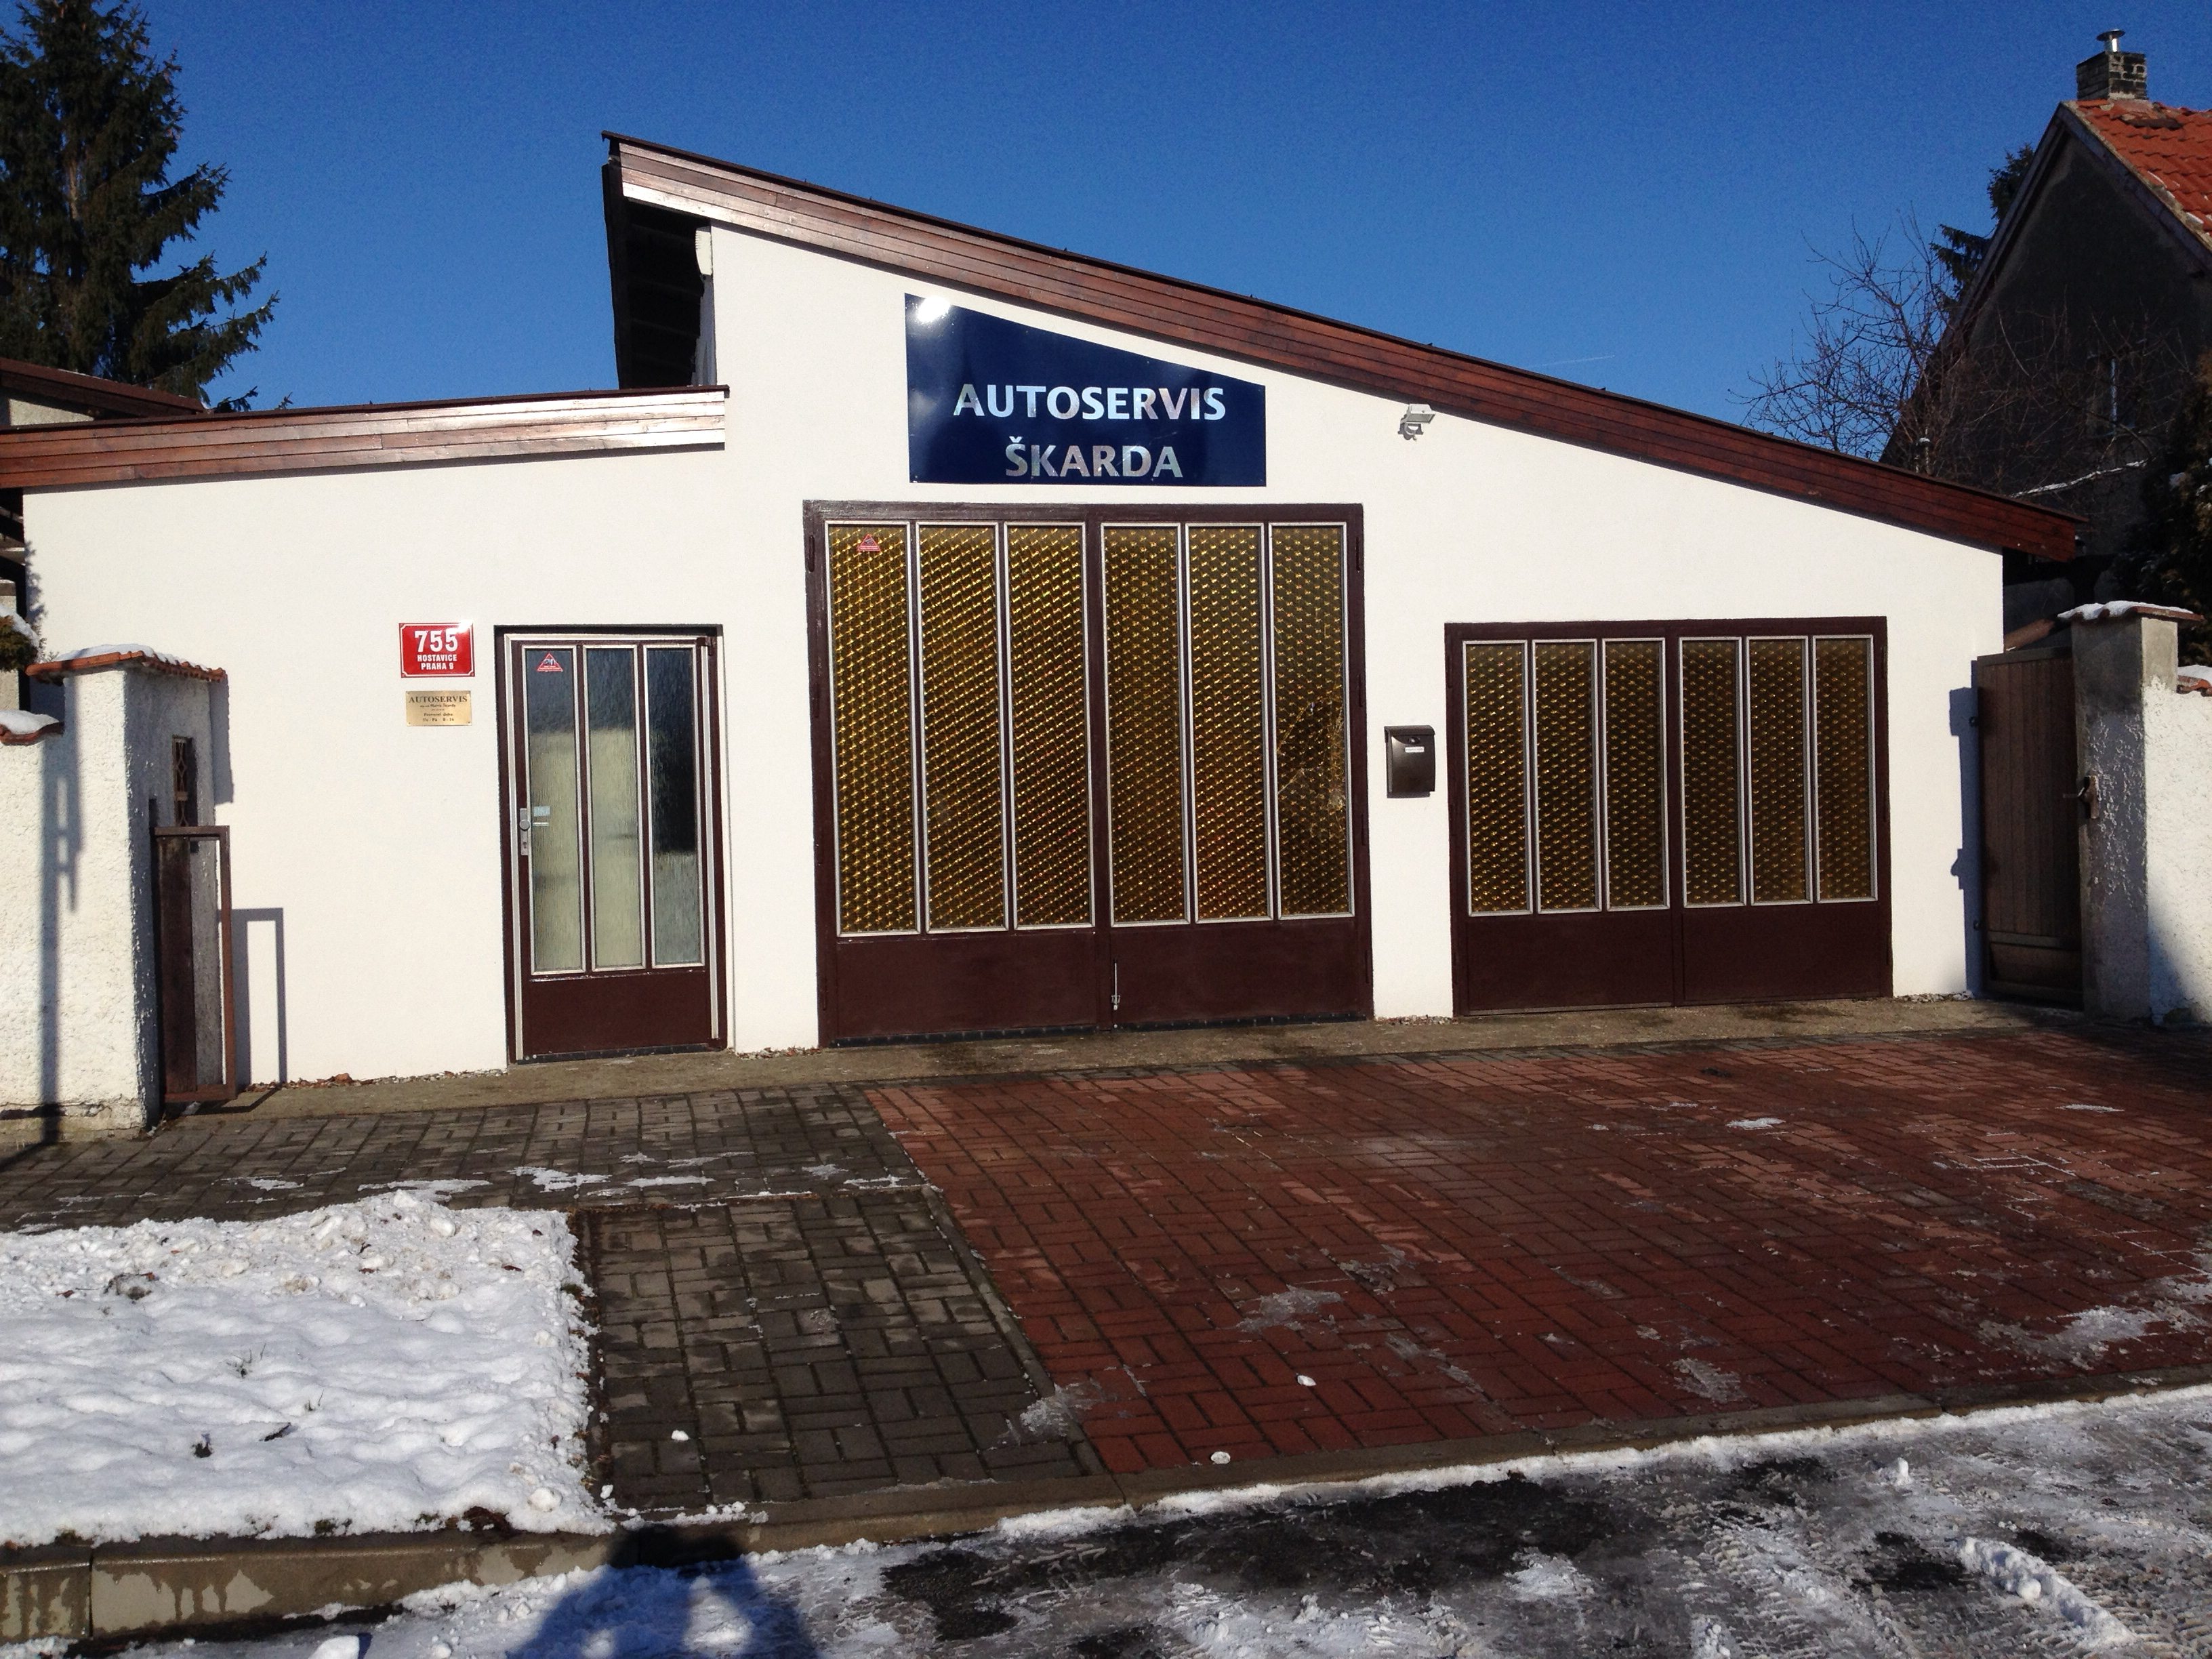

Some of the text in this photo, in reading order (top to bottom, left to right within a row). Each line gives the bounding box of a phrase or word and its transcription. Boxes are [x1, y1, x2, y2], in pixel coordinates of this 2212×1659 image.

[954, 384, 1226, 420] AUTOSERVIS
[1006, 436, 1183, 478] ŠKARDA
[415, 629, 458, 653] 755
[417, 654, 457, 662] HOSTAVICE
[421, 662, 447, 670] PRAHA
[409, 695, 468, 703] AUTOSERVIS
